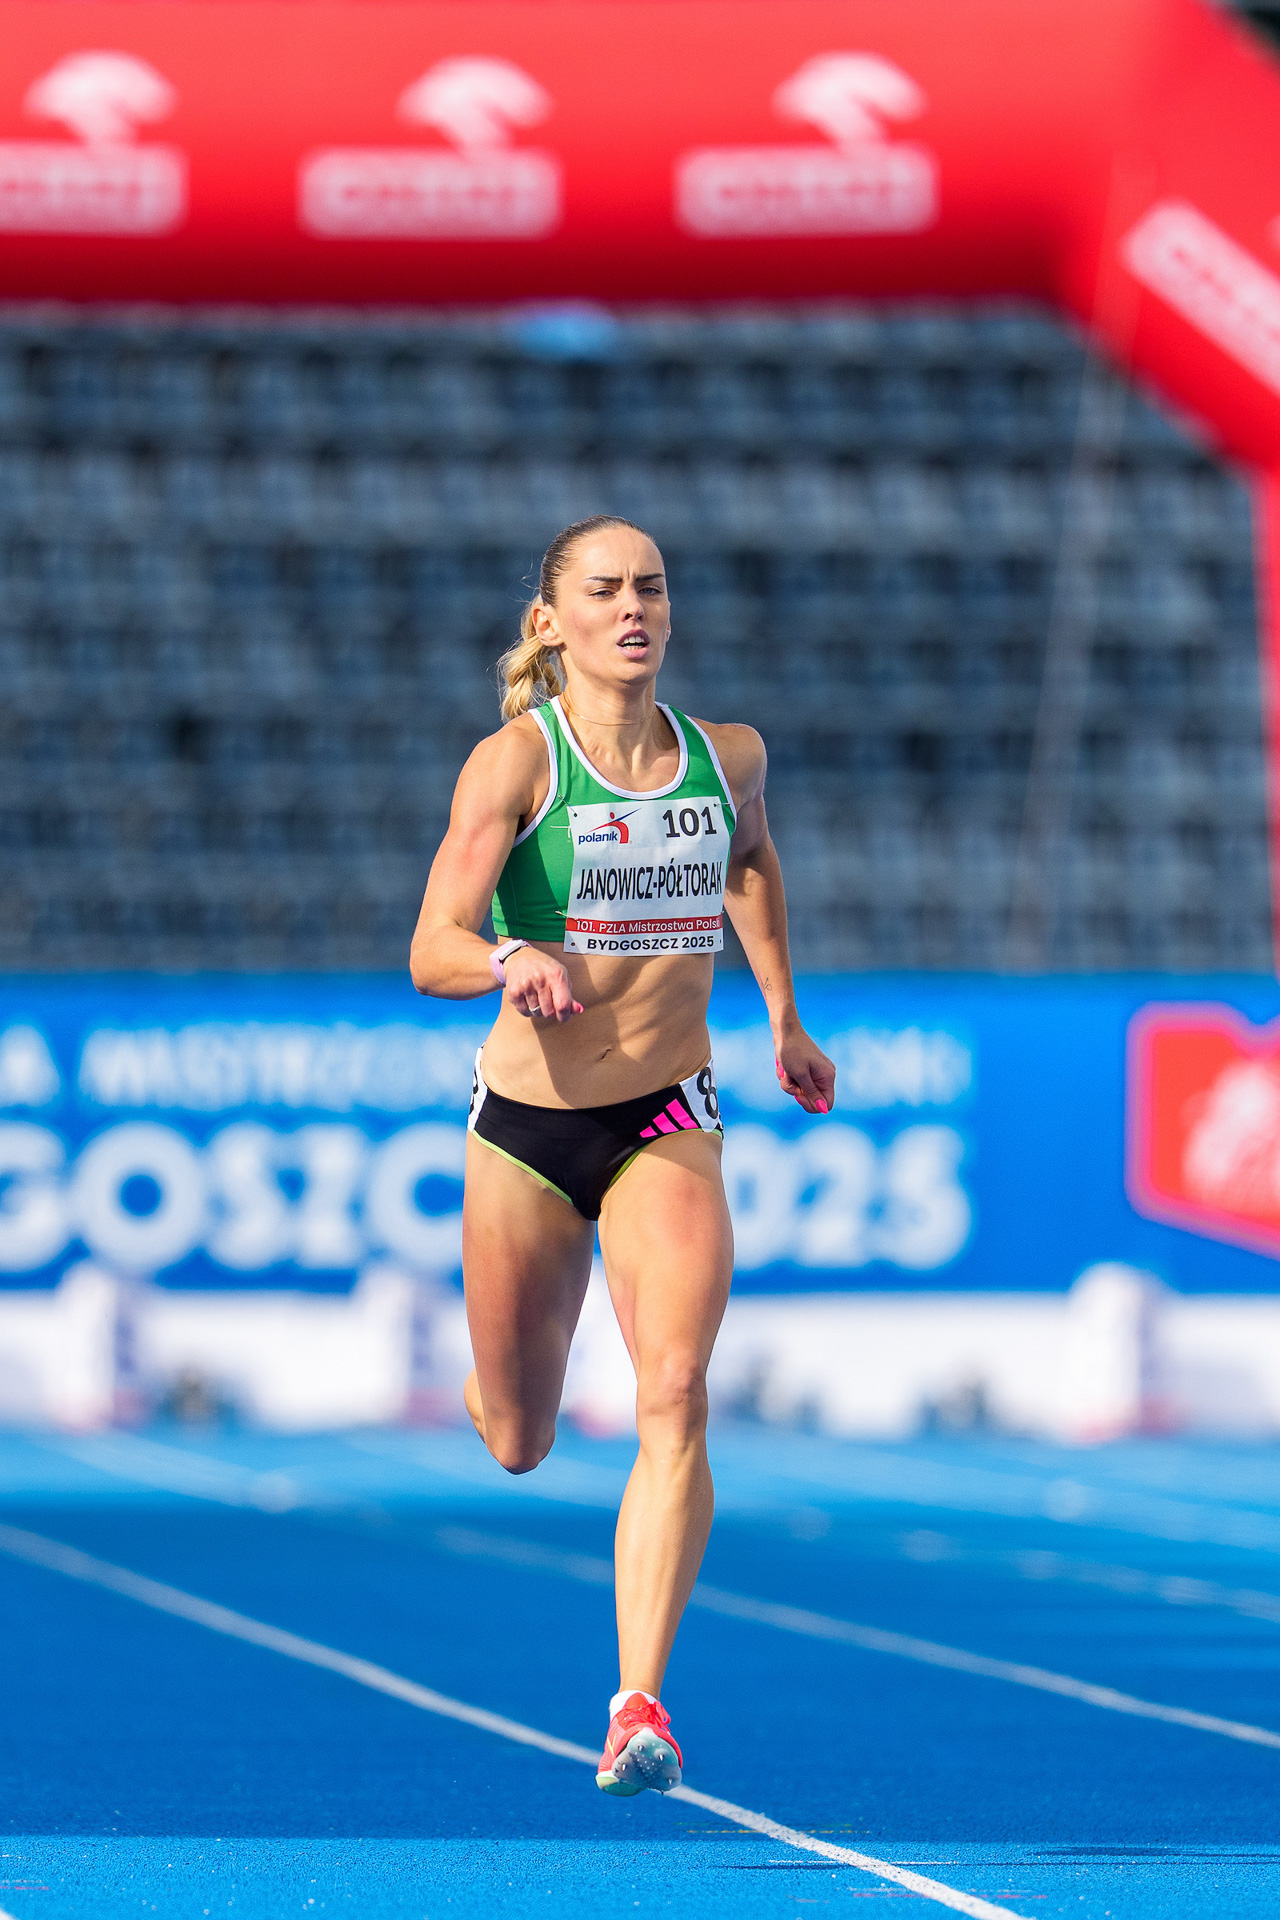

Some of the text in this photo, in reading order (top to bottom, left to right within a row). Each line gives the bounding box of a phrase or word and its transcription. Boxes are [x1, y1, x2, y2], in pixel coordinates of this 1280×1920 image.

[662, 806, 717, 838] 101
[578, 831, 618, 845] polanik
[576, 858, 722, 901] JANOWICZ-PÓŁTORAK
[576, 920, 596, 932] 101.
[599, 922, 626, 933] PZLA
[628, 919, 694, 933] Mistrzostwa
[587, 935, 714, 951] BYDGOSZCZ 2025
[697, 1066, 719, 1120] 8
